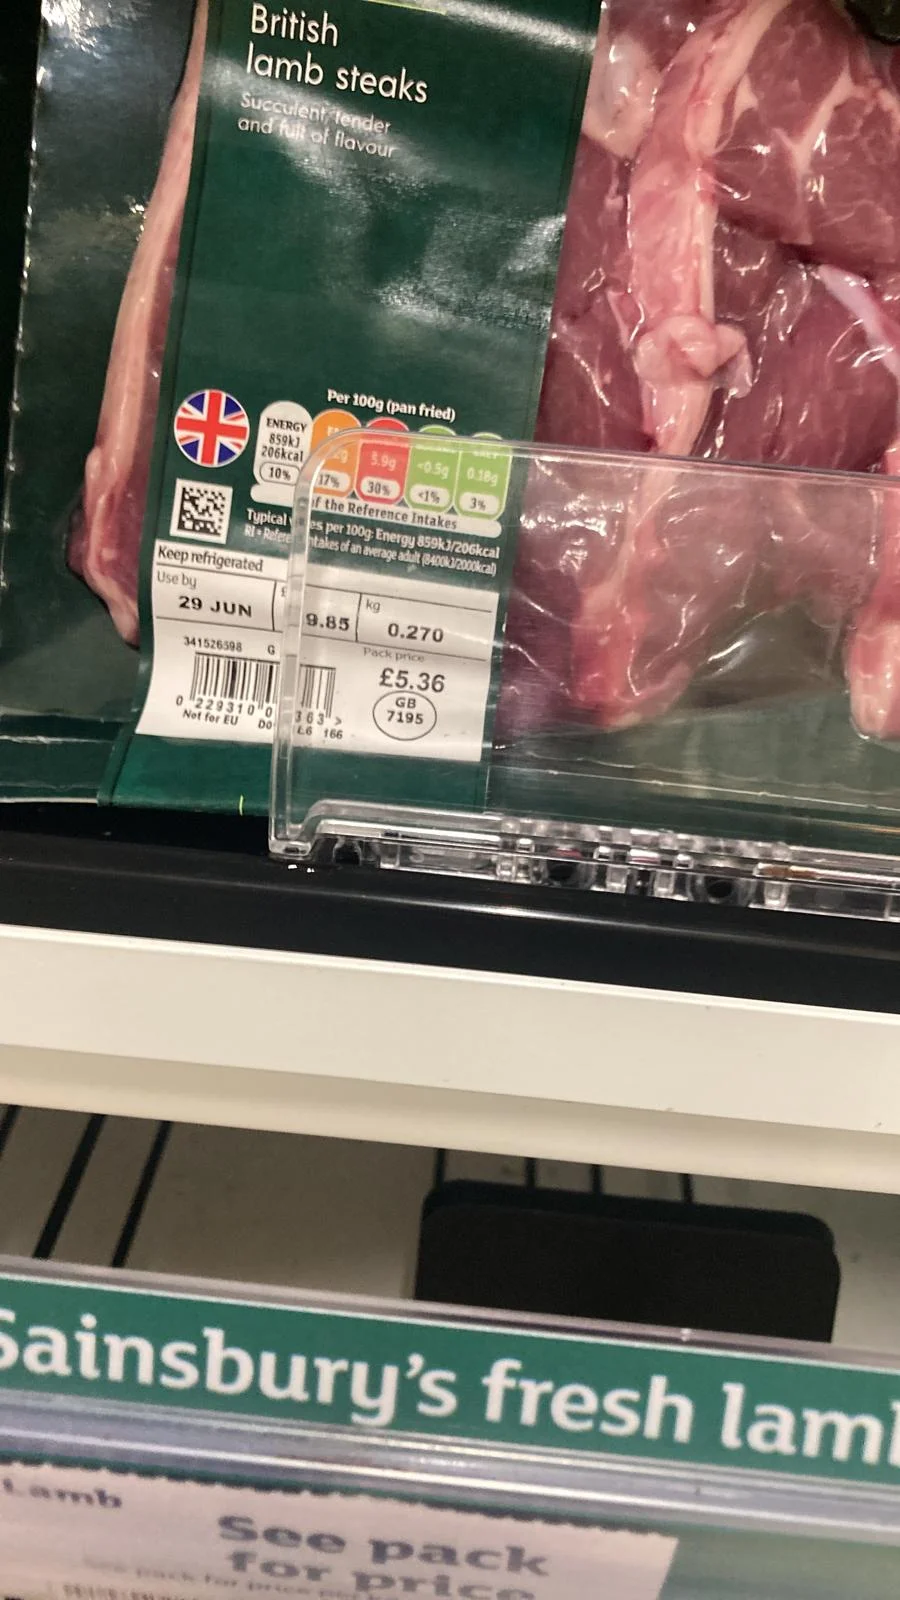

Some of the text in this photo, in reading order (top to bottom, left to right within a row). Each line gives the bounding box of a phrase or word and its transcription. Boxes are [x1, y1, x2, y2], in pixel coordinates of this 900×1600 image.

[251, 2, 338, 47] British
[246, 41, 428, 103] lamb steaks
[334, 109, 391, 134] tender
[237, 117, 396, 158] and full of flavour
[327, 388, 455, 423] Per 100g (pan fried)
[266, 417, 307, 433] ENERGY
[269, 433, 300, 448] 859kJ
[261, 446, 304, 462] 206kcal
[370, 450, 396, 471] 5.9g
[268, 467, 292, 481] 10%
[416, 460, 450, 480] <0.5g
[467, 467, 499, 487] 0.18g
[319, 473, 340, 488] 17%
[367, 481, 391, 493] 30%
[418, 490, 441, 504] <1%
[470, 497, 487, 511] 3%
[325, 499, 345, 513] the
[347, 501, 408, 521] Reference
[411, 510, 457, 530] Intakes
[246, 507, 287, 526] Typical
[325, 522, 344, 535] per
[375, 528, 416, 548] Energy
[417, 535, 500, 559] 859kJ/206kcal
[158, 545, 263, 573] Keep refrigerated
[309, 536, 339, 551] ntakes
[341, 539, 350, 552] of
[350, 543, 362, 554] an
[363, 545, 397, 562] average
[398, 549, 420, 564] adult
[156, 570, 197, 590] Use by
[178, 595, 252, 618] 29 JUN
[365, 600, 381, 613] kg
[305, 612, 350, 631] 9.85
[387, 623, 444, 643] 0.270
[183, 636, 276, 655] 341526598 G
[363, 647, 425, 663] Pack price
[378, 667, 446, 693] £5.36
[176, 695, 184, 706] 0
[395, 697, 416, 709] GB
[182, 709, 202, 721] Not
[204, 711, 220, 723] for
[223, 715, 239, 726] EU
[323, 728, 343, 740] 166
[386, 711, 424, 725] 7195
[481, 1357, 695, 1444] fresh
[218, 1515, 549, 1577] See pack
[227, 1550, 332, 1581] for
[352, 1571, 535, 1600] price
